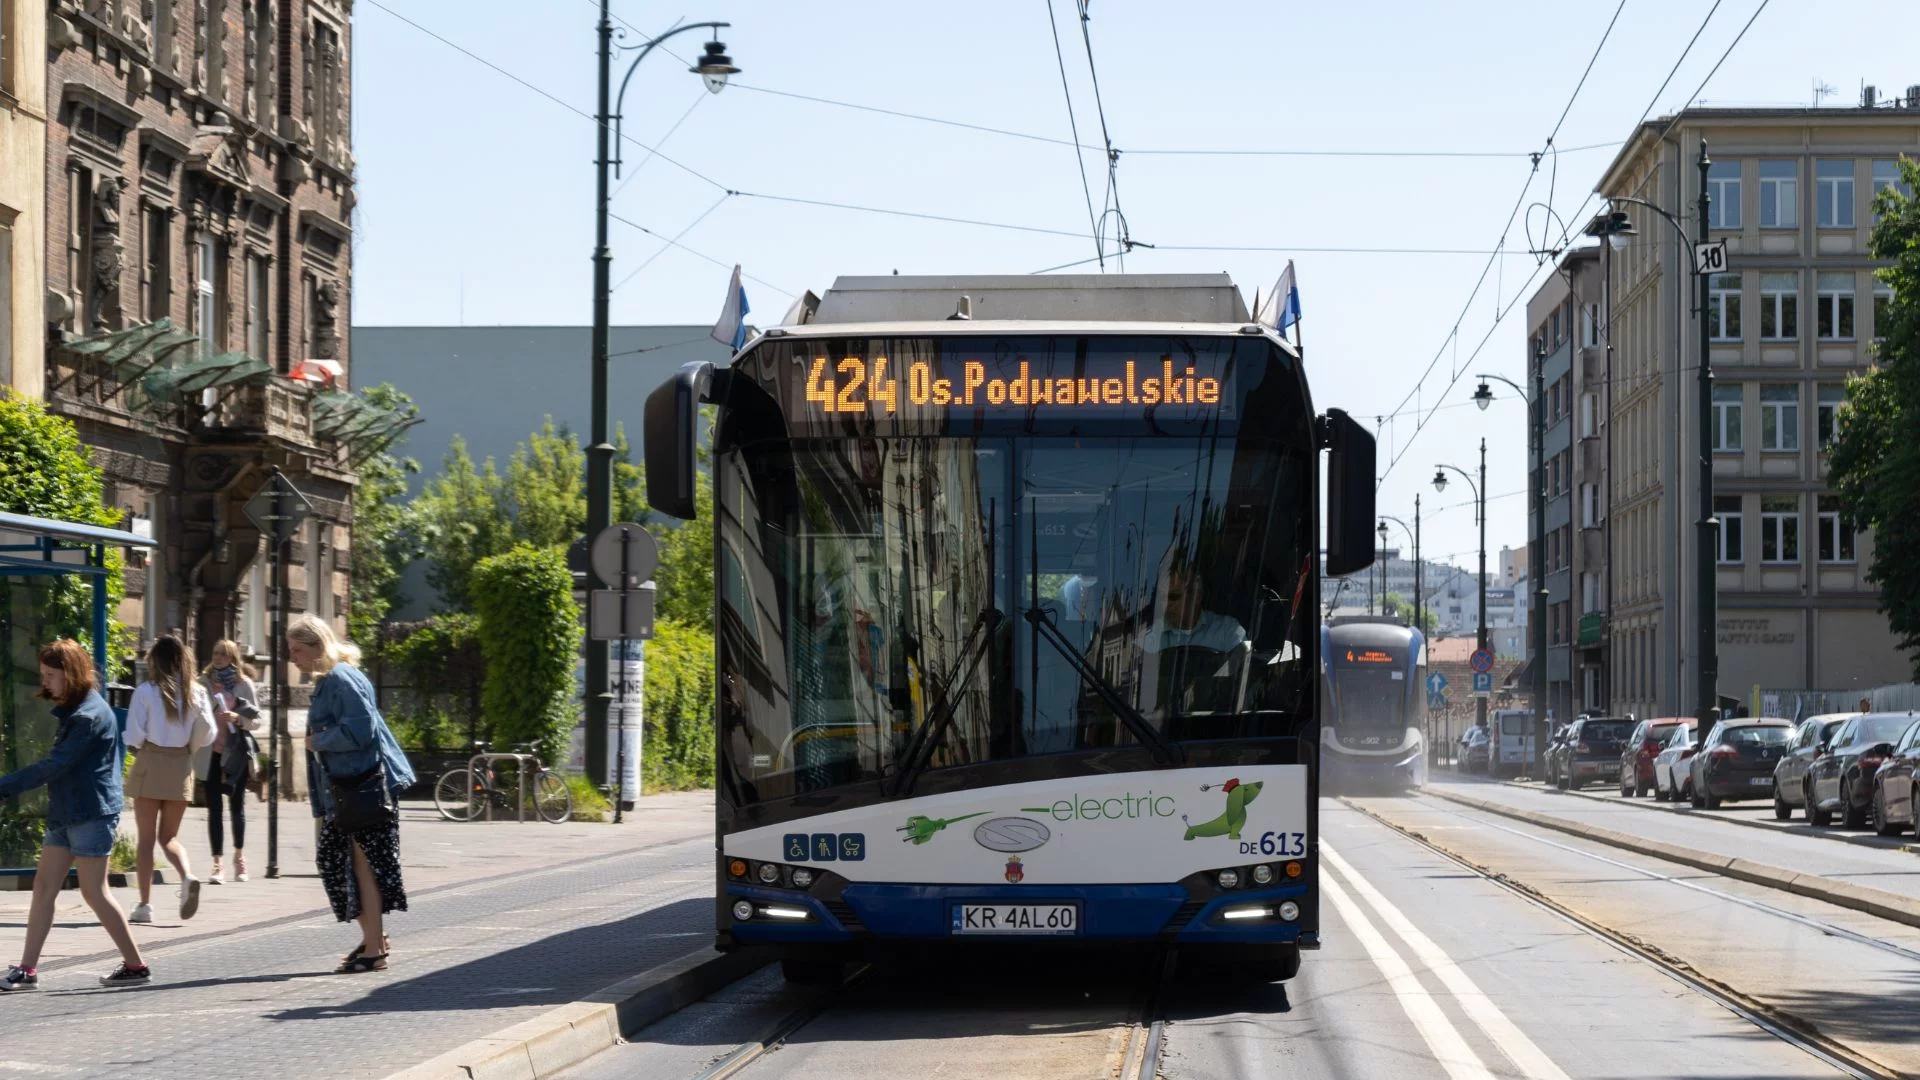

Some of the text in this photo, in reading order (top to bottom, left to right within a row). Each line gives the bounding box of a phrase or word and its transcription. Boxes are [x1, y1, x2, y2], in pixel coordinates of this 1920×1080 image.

[1701, 247, 1722, 269] 10
[806, 358, 1218, 412] 424 Os.Podwawelskie
[1346, 651, 1354, 662] 4
[1477, 674, 1489, 689] P
[1052, 791, 1176, 821] electric
[965, 908, 1072, 928] KR 4AL60
